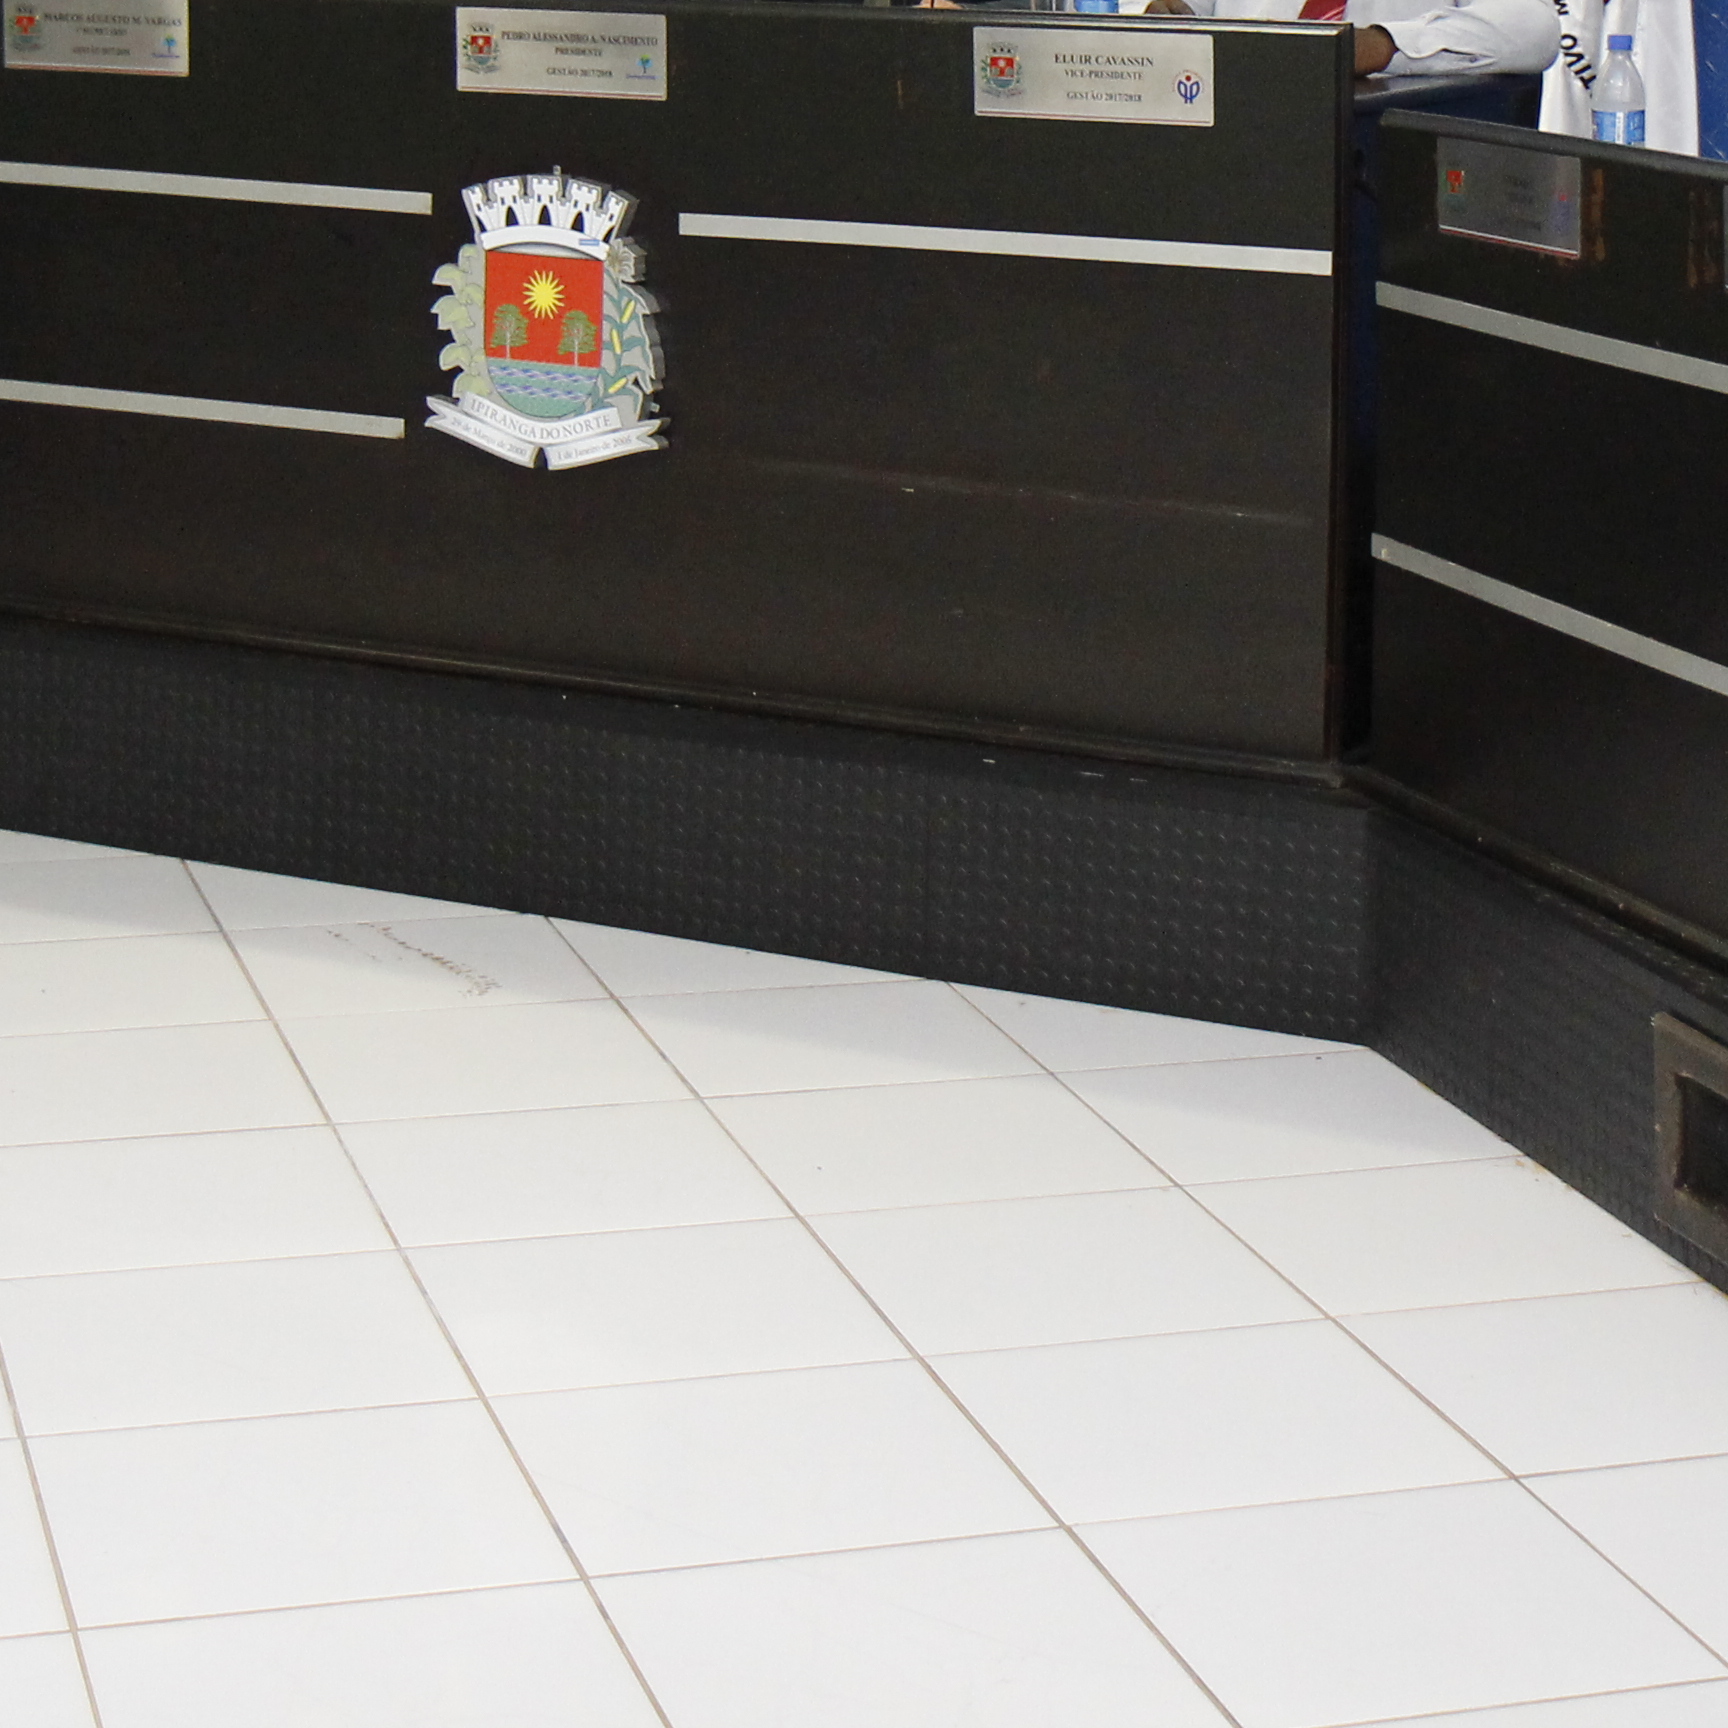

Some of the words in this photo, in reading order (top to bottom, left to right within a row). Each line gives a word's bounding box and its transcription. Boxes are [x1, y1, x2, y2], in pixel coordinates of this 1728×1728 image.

[1054, 53, 1092, 66] ELUIR
[1094, 55, 1154, 67] CAVASSIN
[1064, 69, 1144, 81] VICE-PRESIDENTE
[1066, 89, 1103, 101] GESTÃO
[471, 399, 537, 440] IPIRANGA
[539, 427, 561, 440] DO
[563, 414, 612, 438] NORTE
